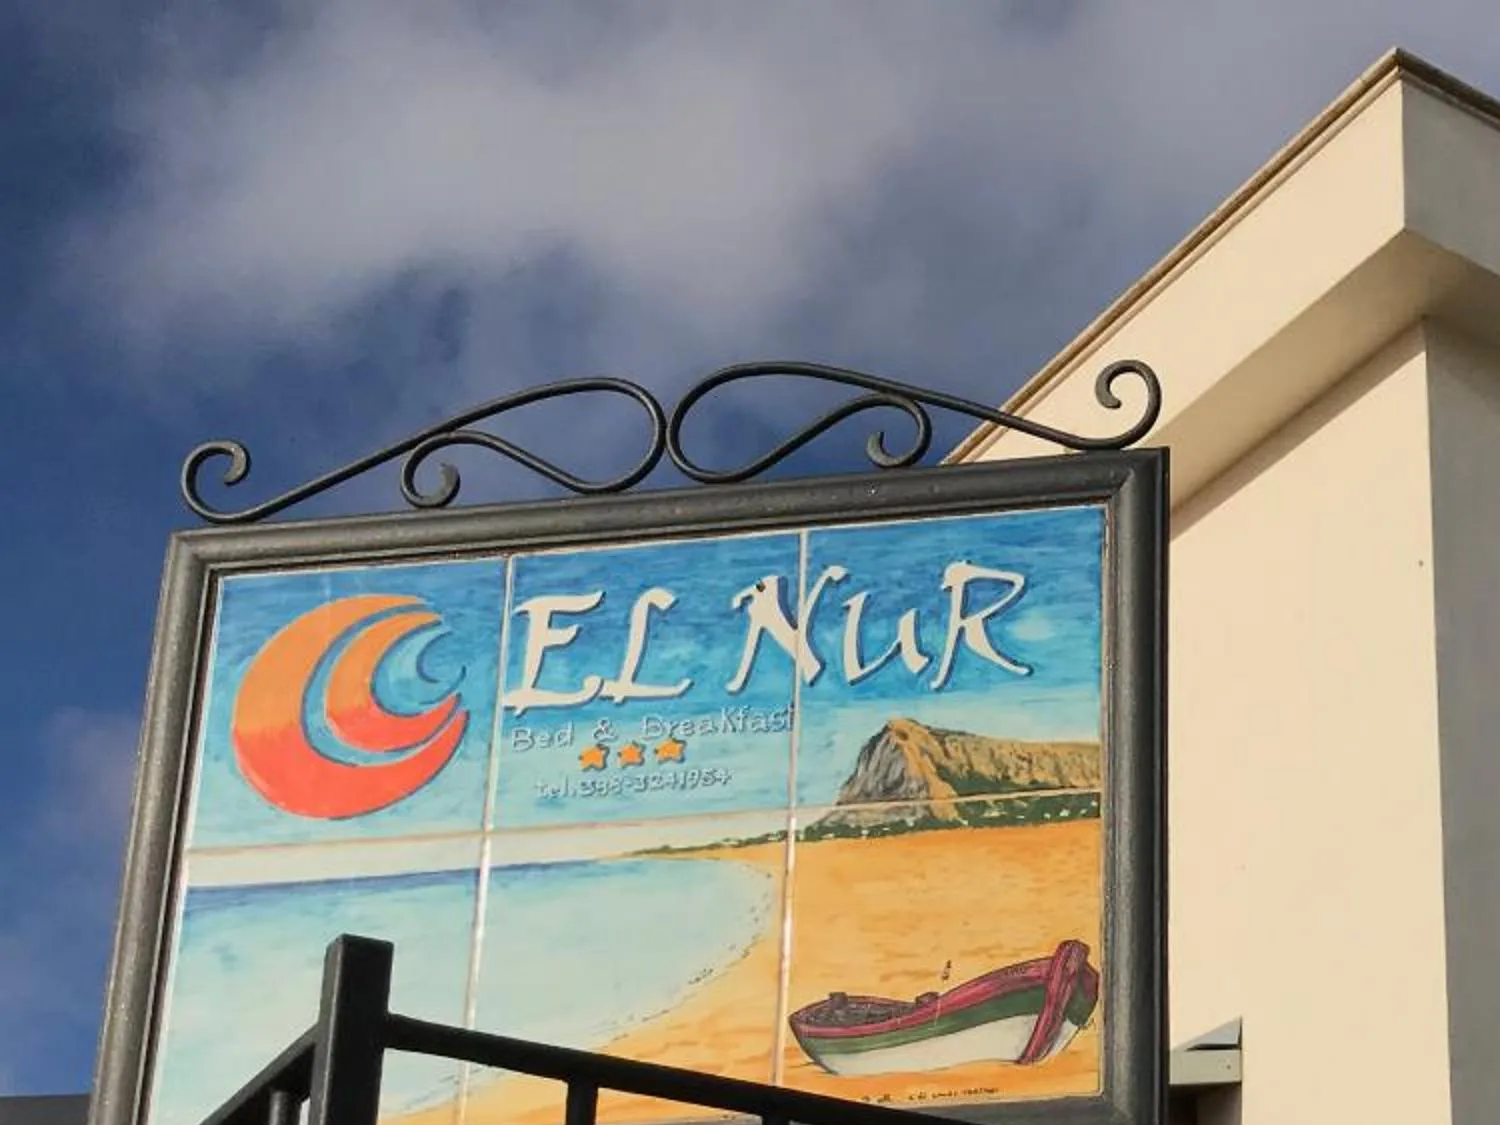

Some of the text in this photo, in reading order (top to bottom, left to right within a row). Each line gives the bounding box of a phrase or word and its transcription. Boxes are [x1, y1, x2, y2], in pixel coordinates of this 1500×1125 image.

[502, 588, 693, 714] EL
[511, 723, 575, 752] Bed
[592, 717, 619, 742] &
